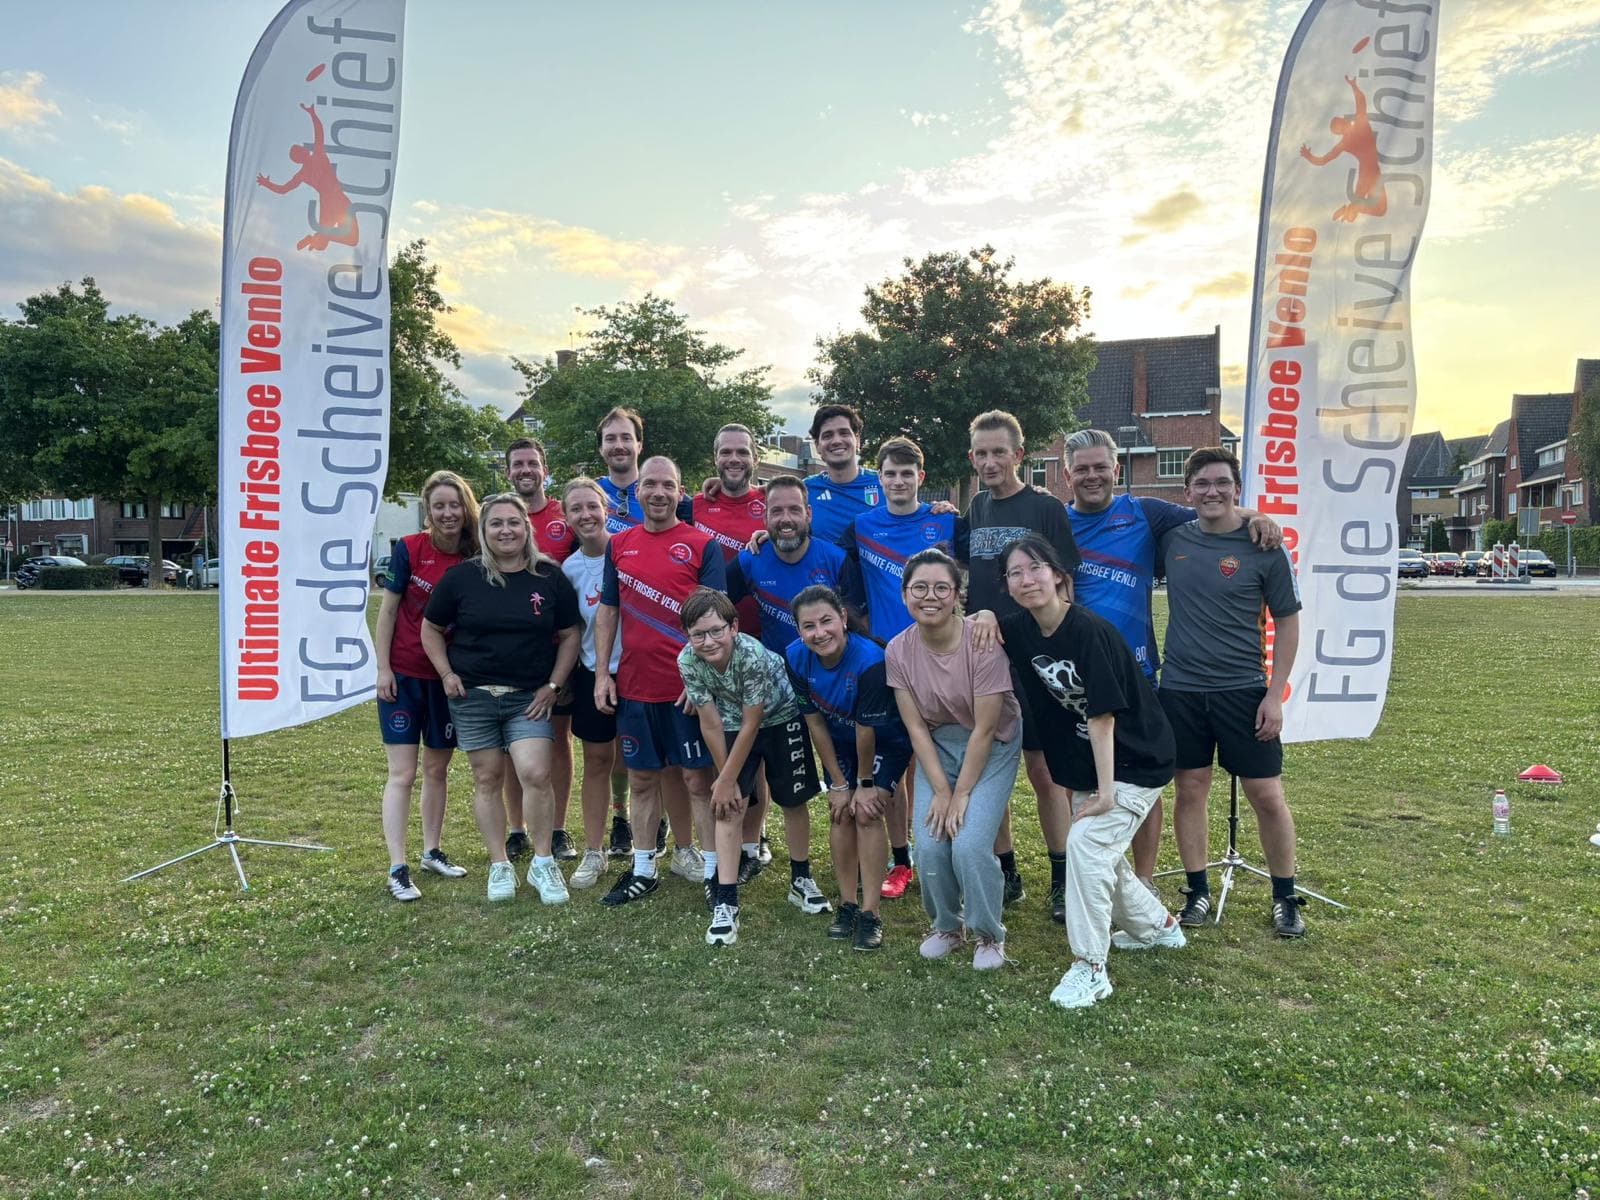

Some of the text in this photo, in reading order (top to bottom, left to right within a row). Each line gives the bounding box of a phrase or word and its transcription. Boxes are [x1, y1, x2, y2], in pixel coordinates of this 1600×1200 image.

[1266, 226, 1318, 350] Venlo
[295, 15, 397, 703] FG de Scheive Schief
[1315, 233, 1417, 495] Scheive
[1257, 359, 1302, 516] Frisbee
[237, 256, 283, 701] Ultimate Frisbee Venlo
[606, 517, 631, 532] FRISB
[1312, 520, 1393, 602] de
[632, 579, 662, 603] FRISBEE
[884, 561, 904, 579] FRIS
[1078, 561, 1137, 588] RISBEE VENLO
[1135, 645, 1147, 662] 80
[1306, 628, 1386, 703] FG
[683, 739, 701, 760] 11
[786, 721, 806, 794] PARIS
